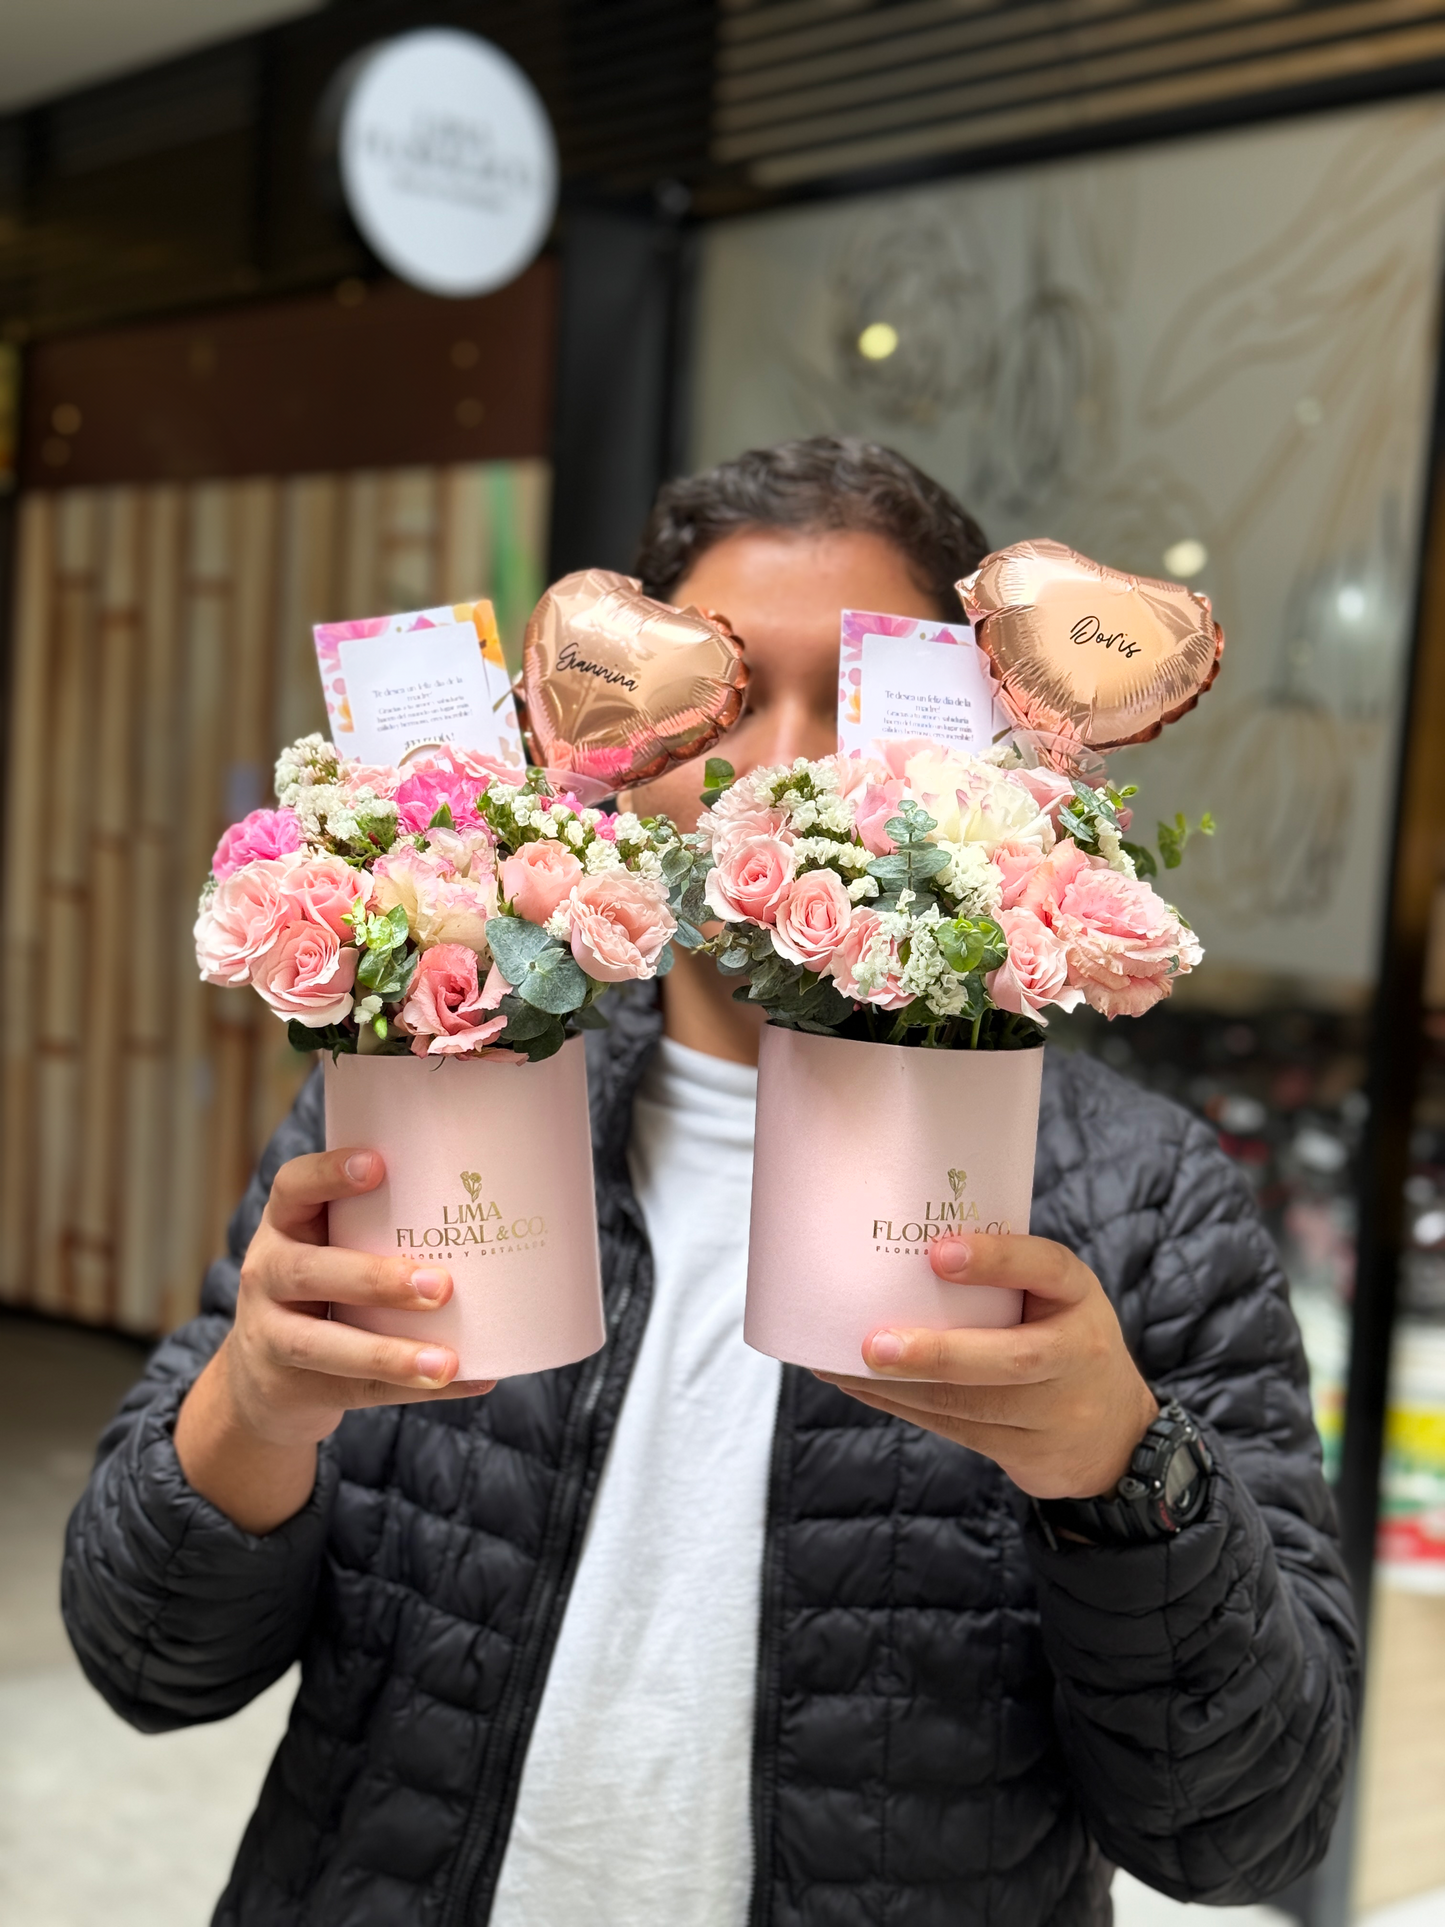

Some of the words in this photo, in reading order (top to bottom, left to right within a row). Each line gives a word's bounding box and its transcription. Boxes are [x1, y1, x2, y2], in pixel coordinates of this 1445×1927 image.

[1069, 615, 1142, 659] Doris
[556, 642, 639, 692] Giannina
[885, 690, 894, 698] Te
[954, 697, 963, 707] de
[964, 698, 971, 707] la
[442, 1201, 503, 1225] LIMA
[925, 1201, 980, 1221] LIMA
[396, 1224, 494, 1248] FLORAL
[496, 1225, 509, 1241] &
[872, 1219, 963, 1243] FLORAL
[402, 1252, 453, 1260] FLORES
[481, 1240, 546, 1256] DETALLES
[876, 1245, 929, 1256] FLORES
